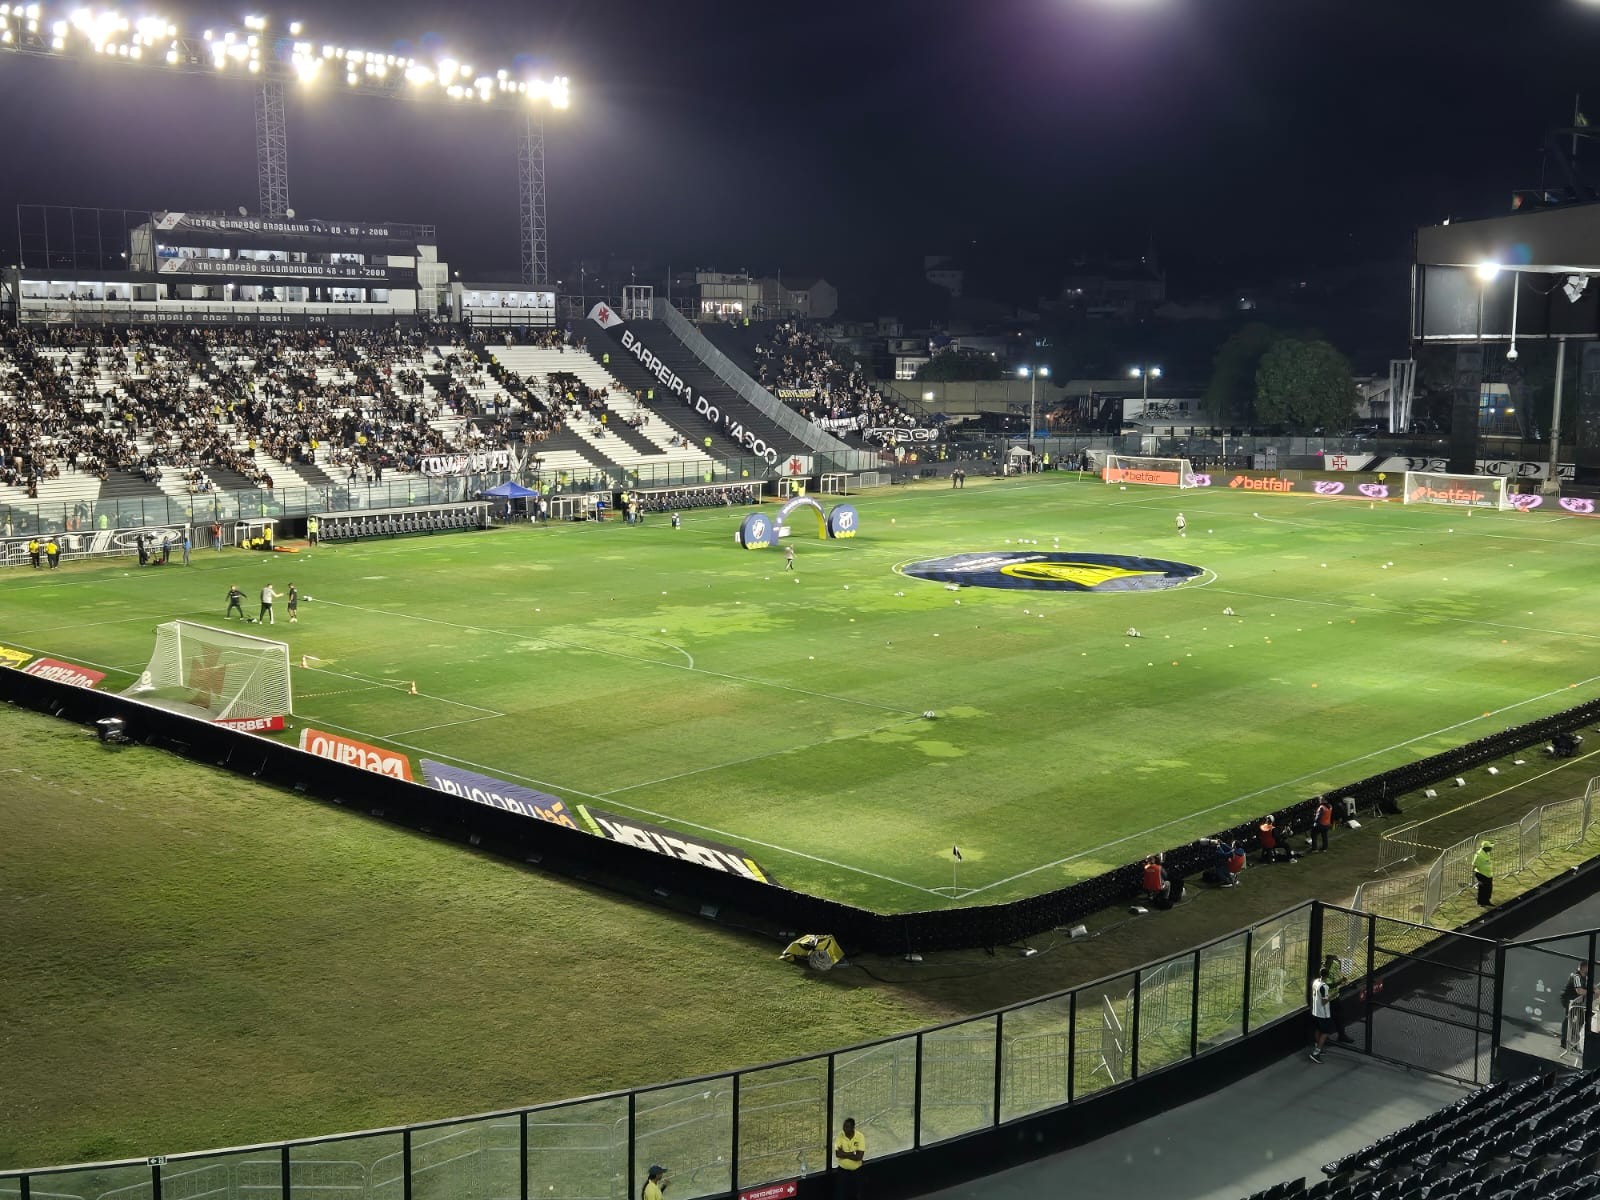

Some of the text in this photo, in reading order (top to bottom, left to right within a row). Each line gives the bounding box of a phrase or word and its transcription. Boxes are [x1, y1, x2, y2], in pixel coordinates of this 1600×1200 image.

[621, 329, 692, 405] BARREIRA
[695, 395, 720, 423] DO
[1242, 476, 1295, 492] betfair
